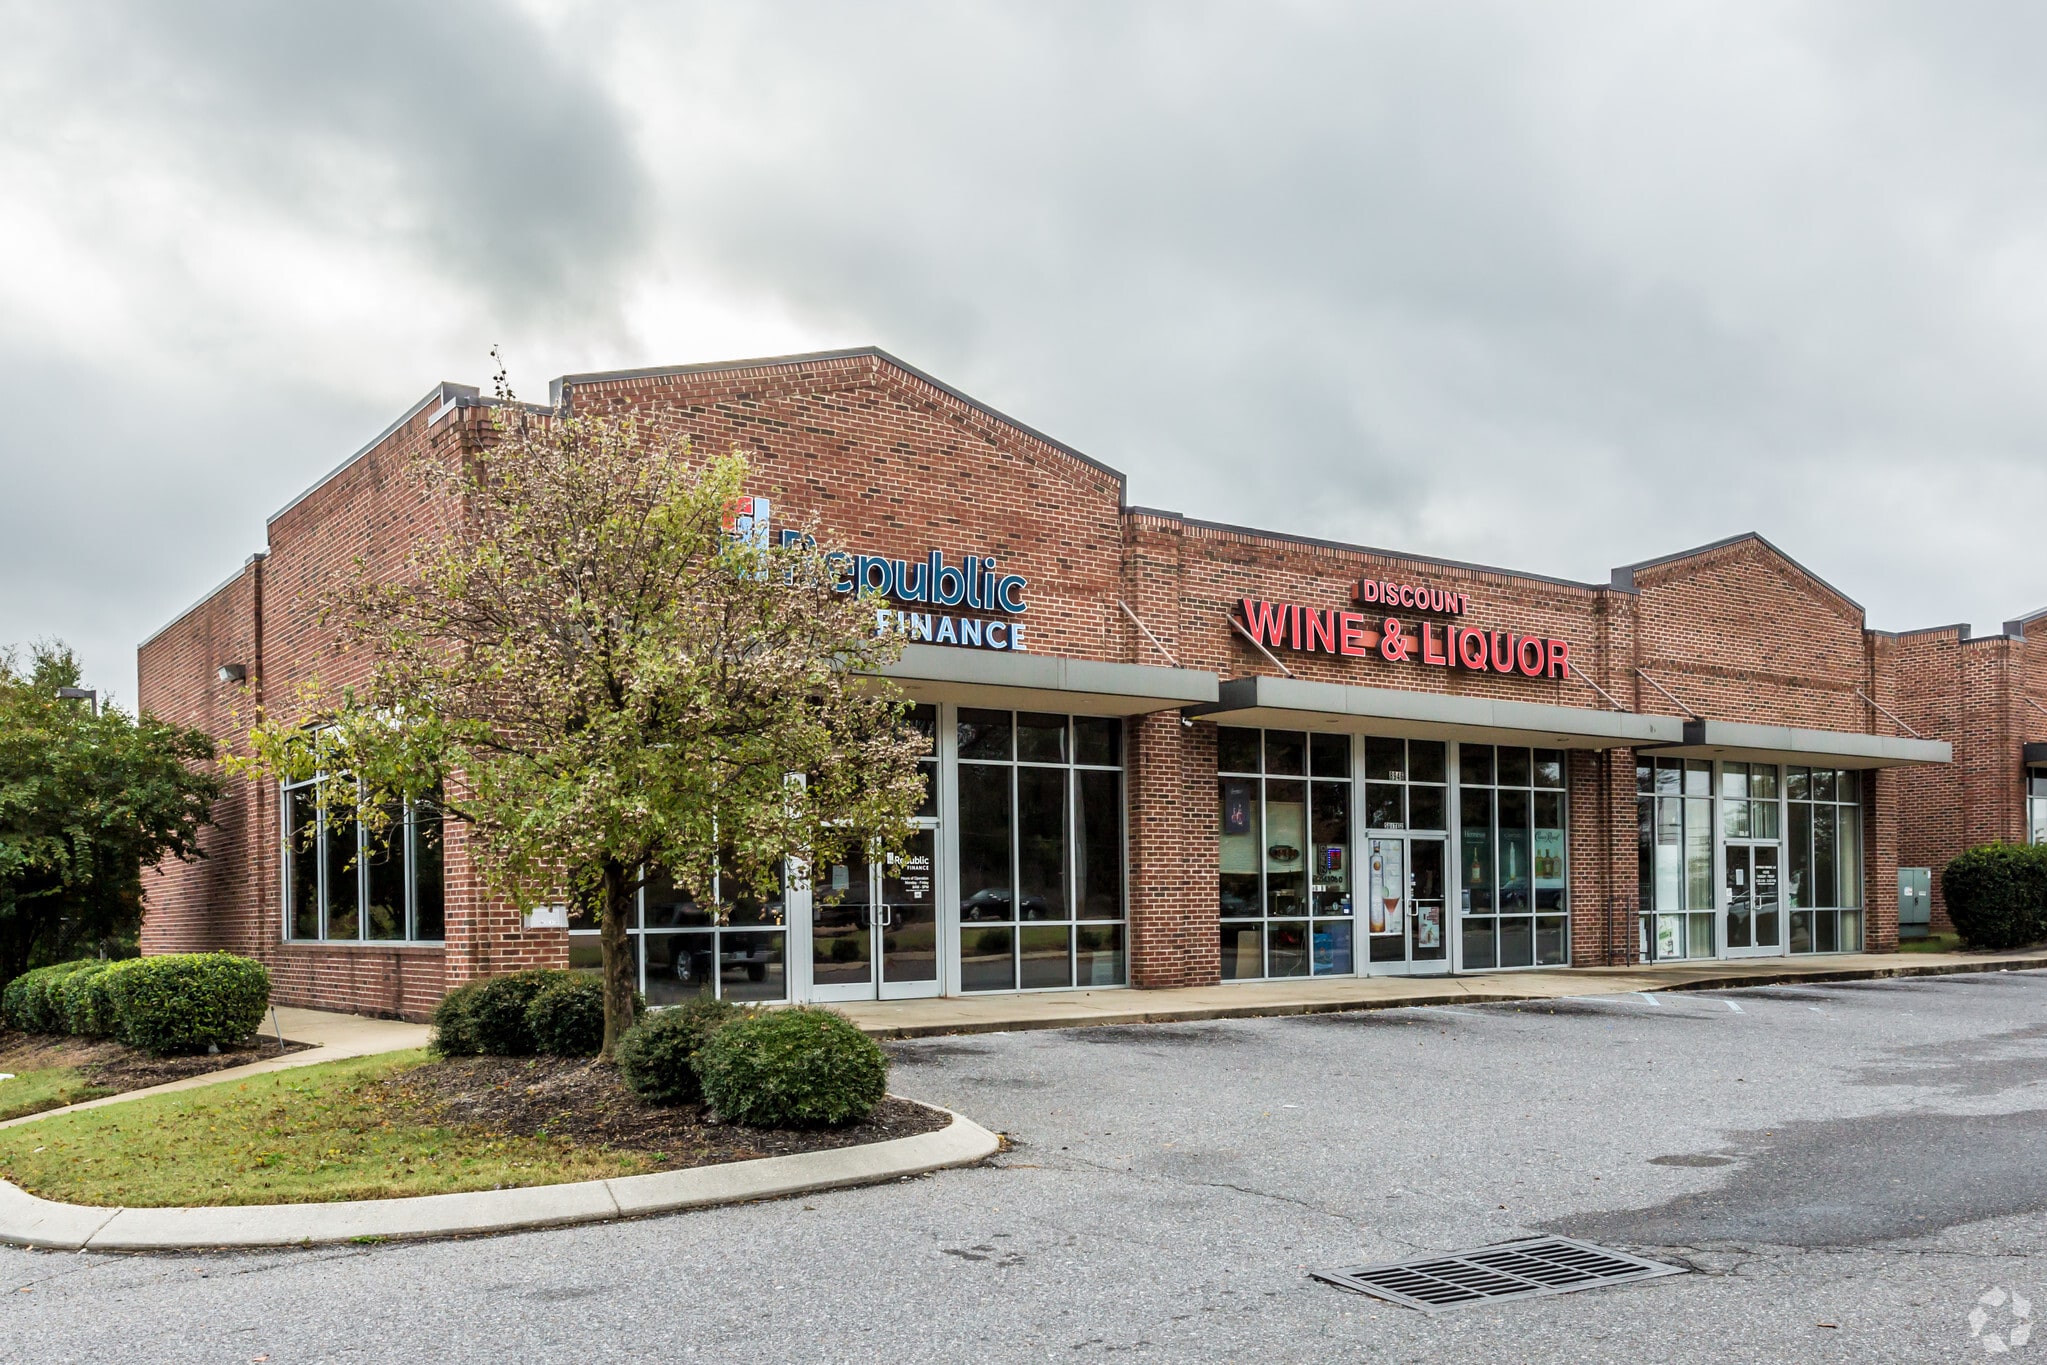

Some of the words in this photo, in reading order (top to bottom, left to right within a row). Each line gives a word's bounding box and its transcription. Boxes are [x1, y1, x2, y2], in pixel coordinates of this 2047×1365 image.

[1363, 579, 1470, 615] DISCOUNT
[875, 608, 1027, 650] FINANCE
[1240, 597, 1366, 658] WINE
[1380, 617, 1410, 662] &
[1422, 621, 1570, 679] LIQUOR
[894, 855, 929, 864] Reublic
